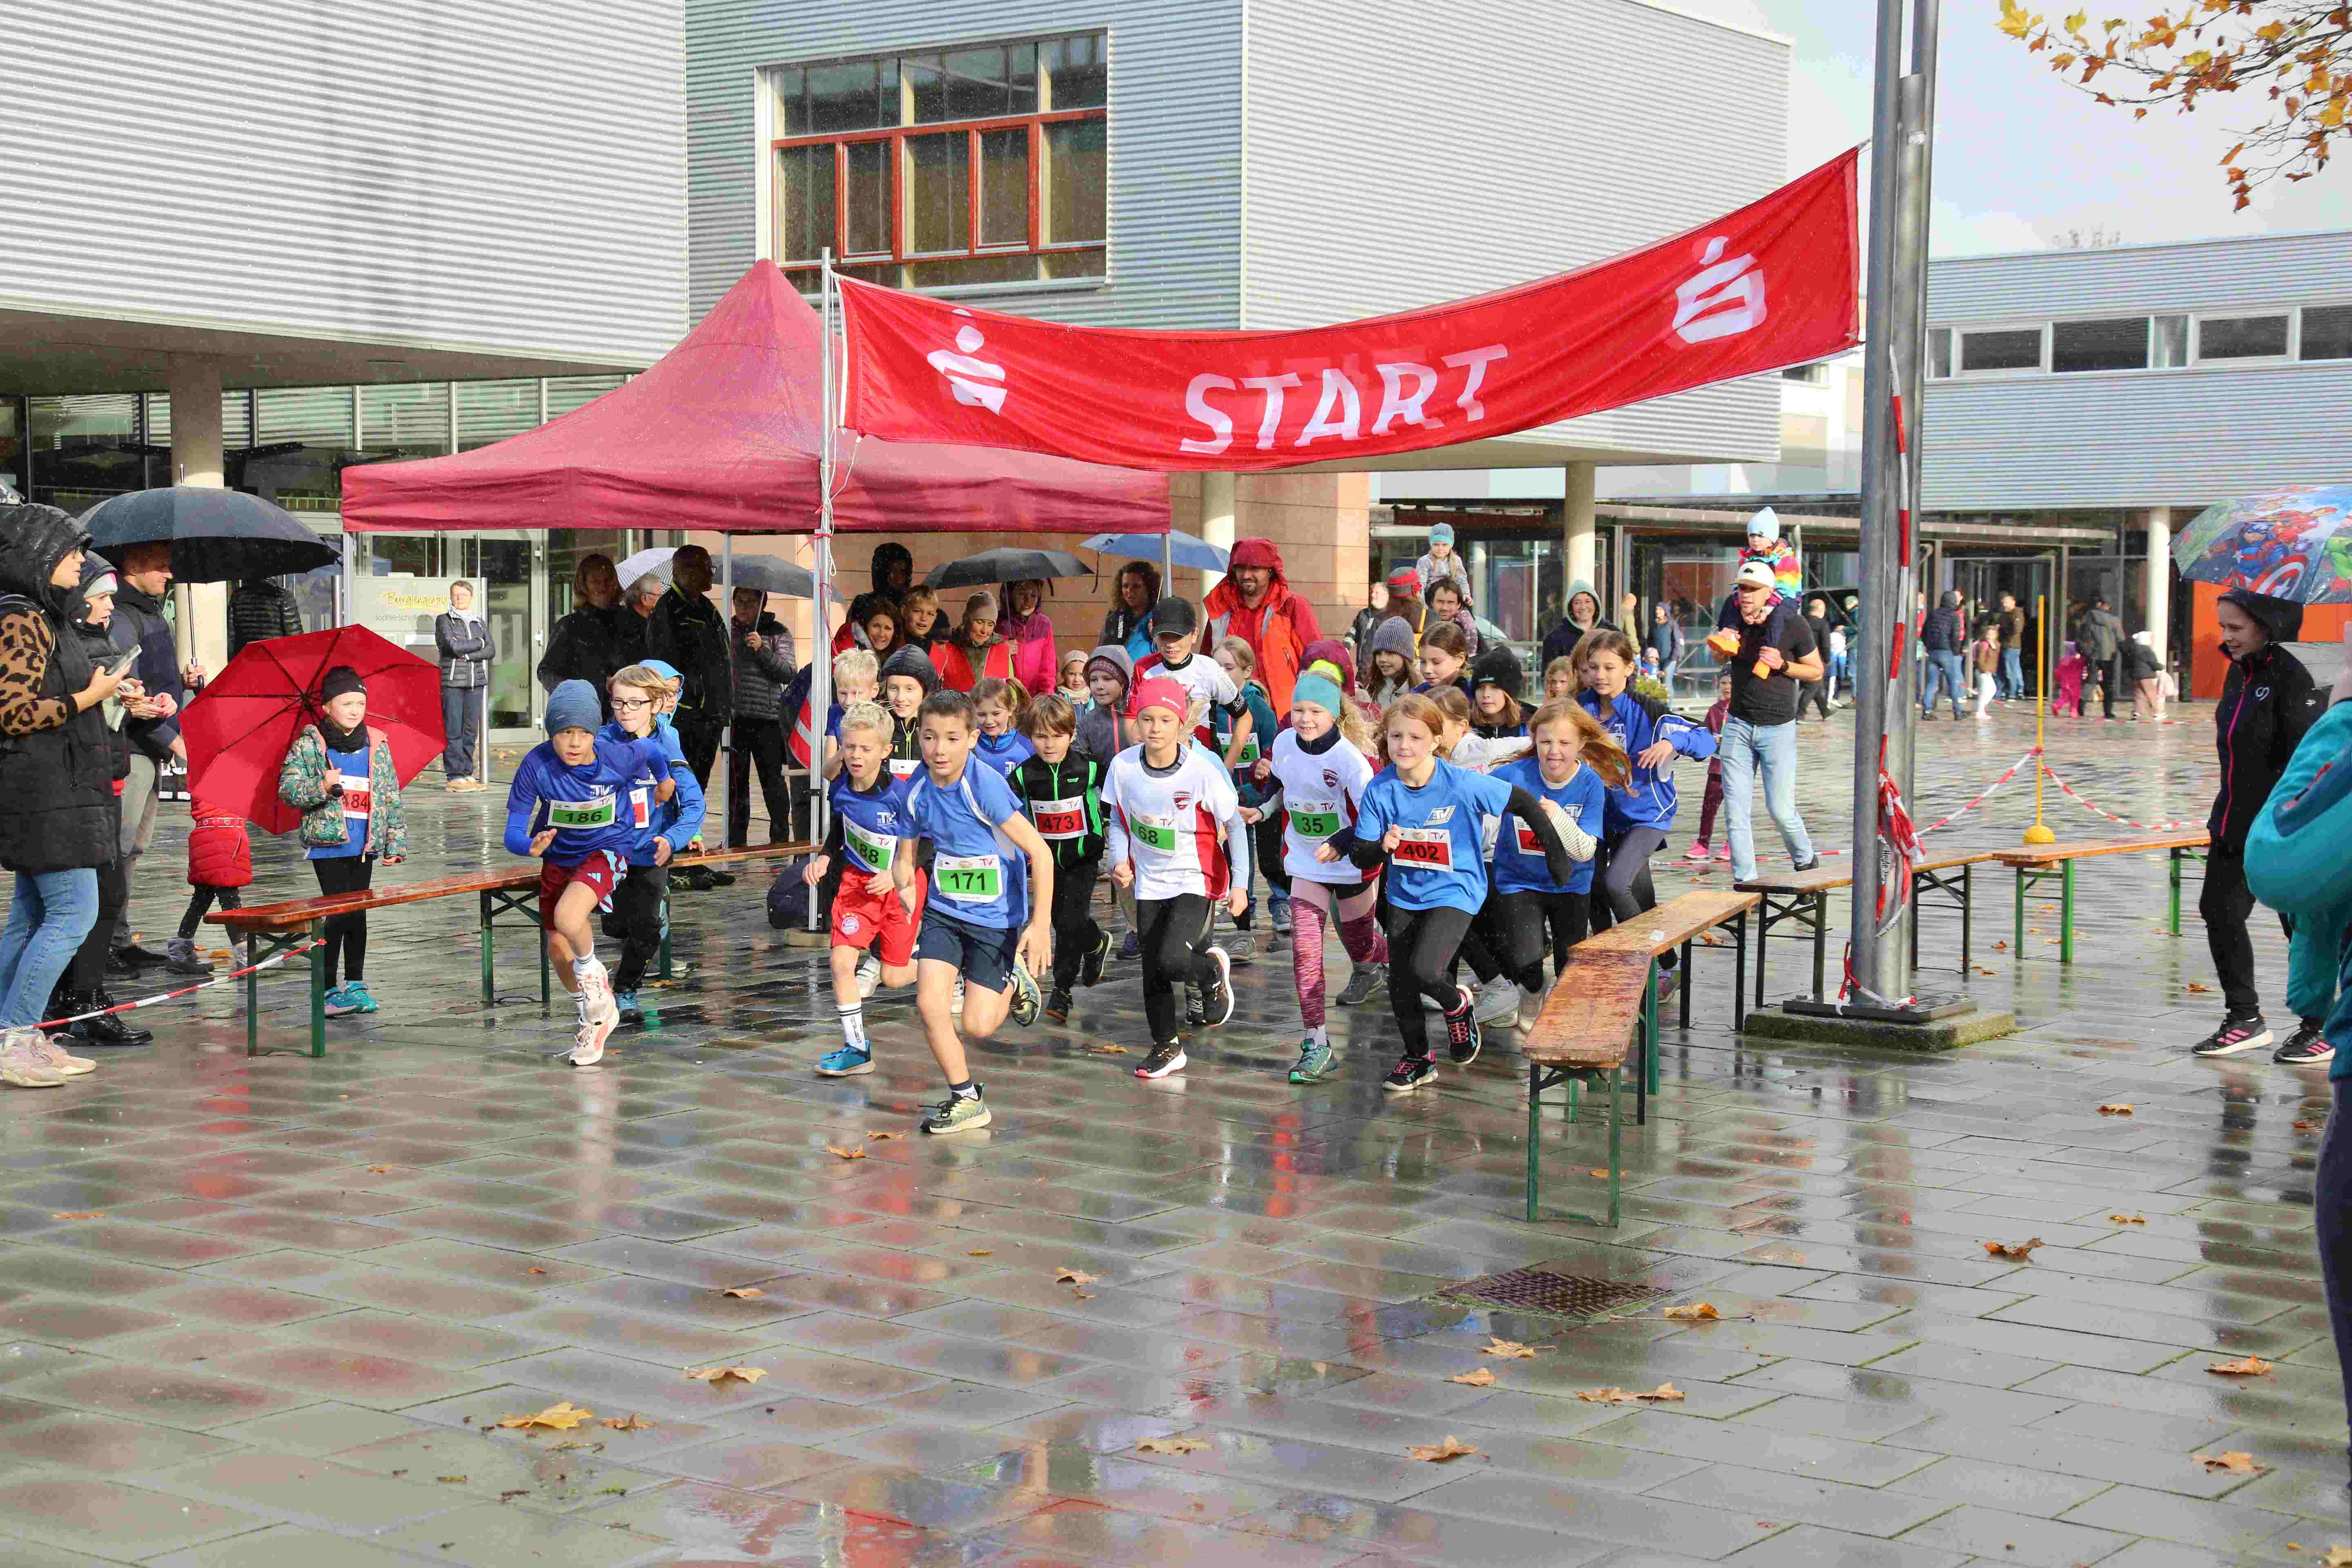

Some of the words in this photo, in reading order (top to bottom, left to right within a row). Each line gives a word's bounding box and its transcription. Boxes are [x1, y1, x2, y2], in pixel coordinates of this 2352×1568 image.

[1179, 343, 1509, 454] START
[565, 811, 603, 823] 186
[1045, 815, 1074, 831] 473
[1302, 817, 1323, 833] 35
[1138, 826, 1158, 844] 68
[853, 838, 879, 864] 188
[1404, 844, 1440, 861] 402
[951, 873, 985, 891] 171
